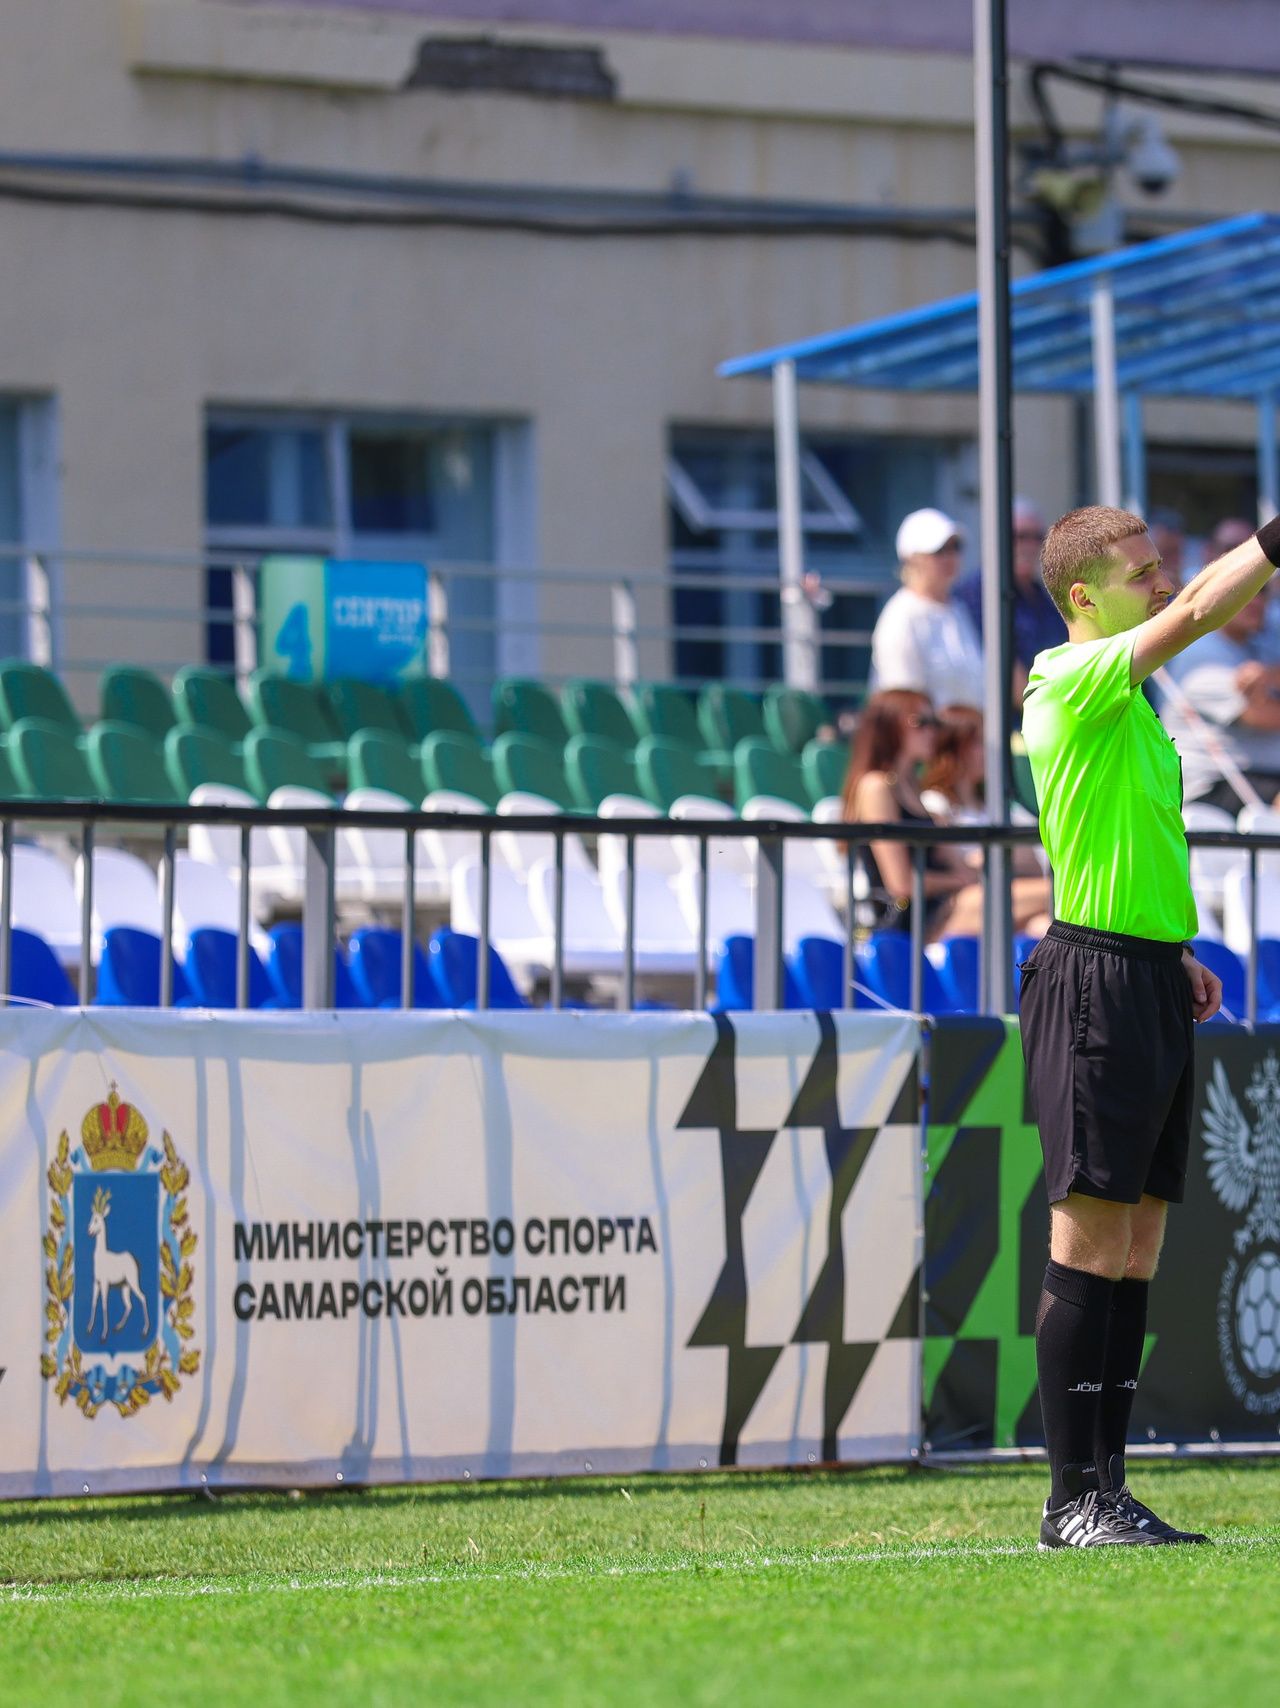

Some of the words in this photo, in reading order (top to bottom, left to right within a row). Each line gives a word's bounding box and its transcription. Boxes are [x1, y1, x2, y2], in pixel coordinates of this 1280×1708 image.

[233, 1217, 515, 1260] МИНИСТЕРСТВО
[523, 1216, 658, 1255] СПОРТА
[233, 1267, 453, 1321] САМАРСКОЙ
[464, 1275, 625, 1316] ОБЛАСТИ
[1068, 1382, 1102, 1392] JÖG
